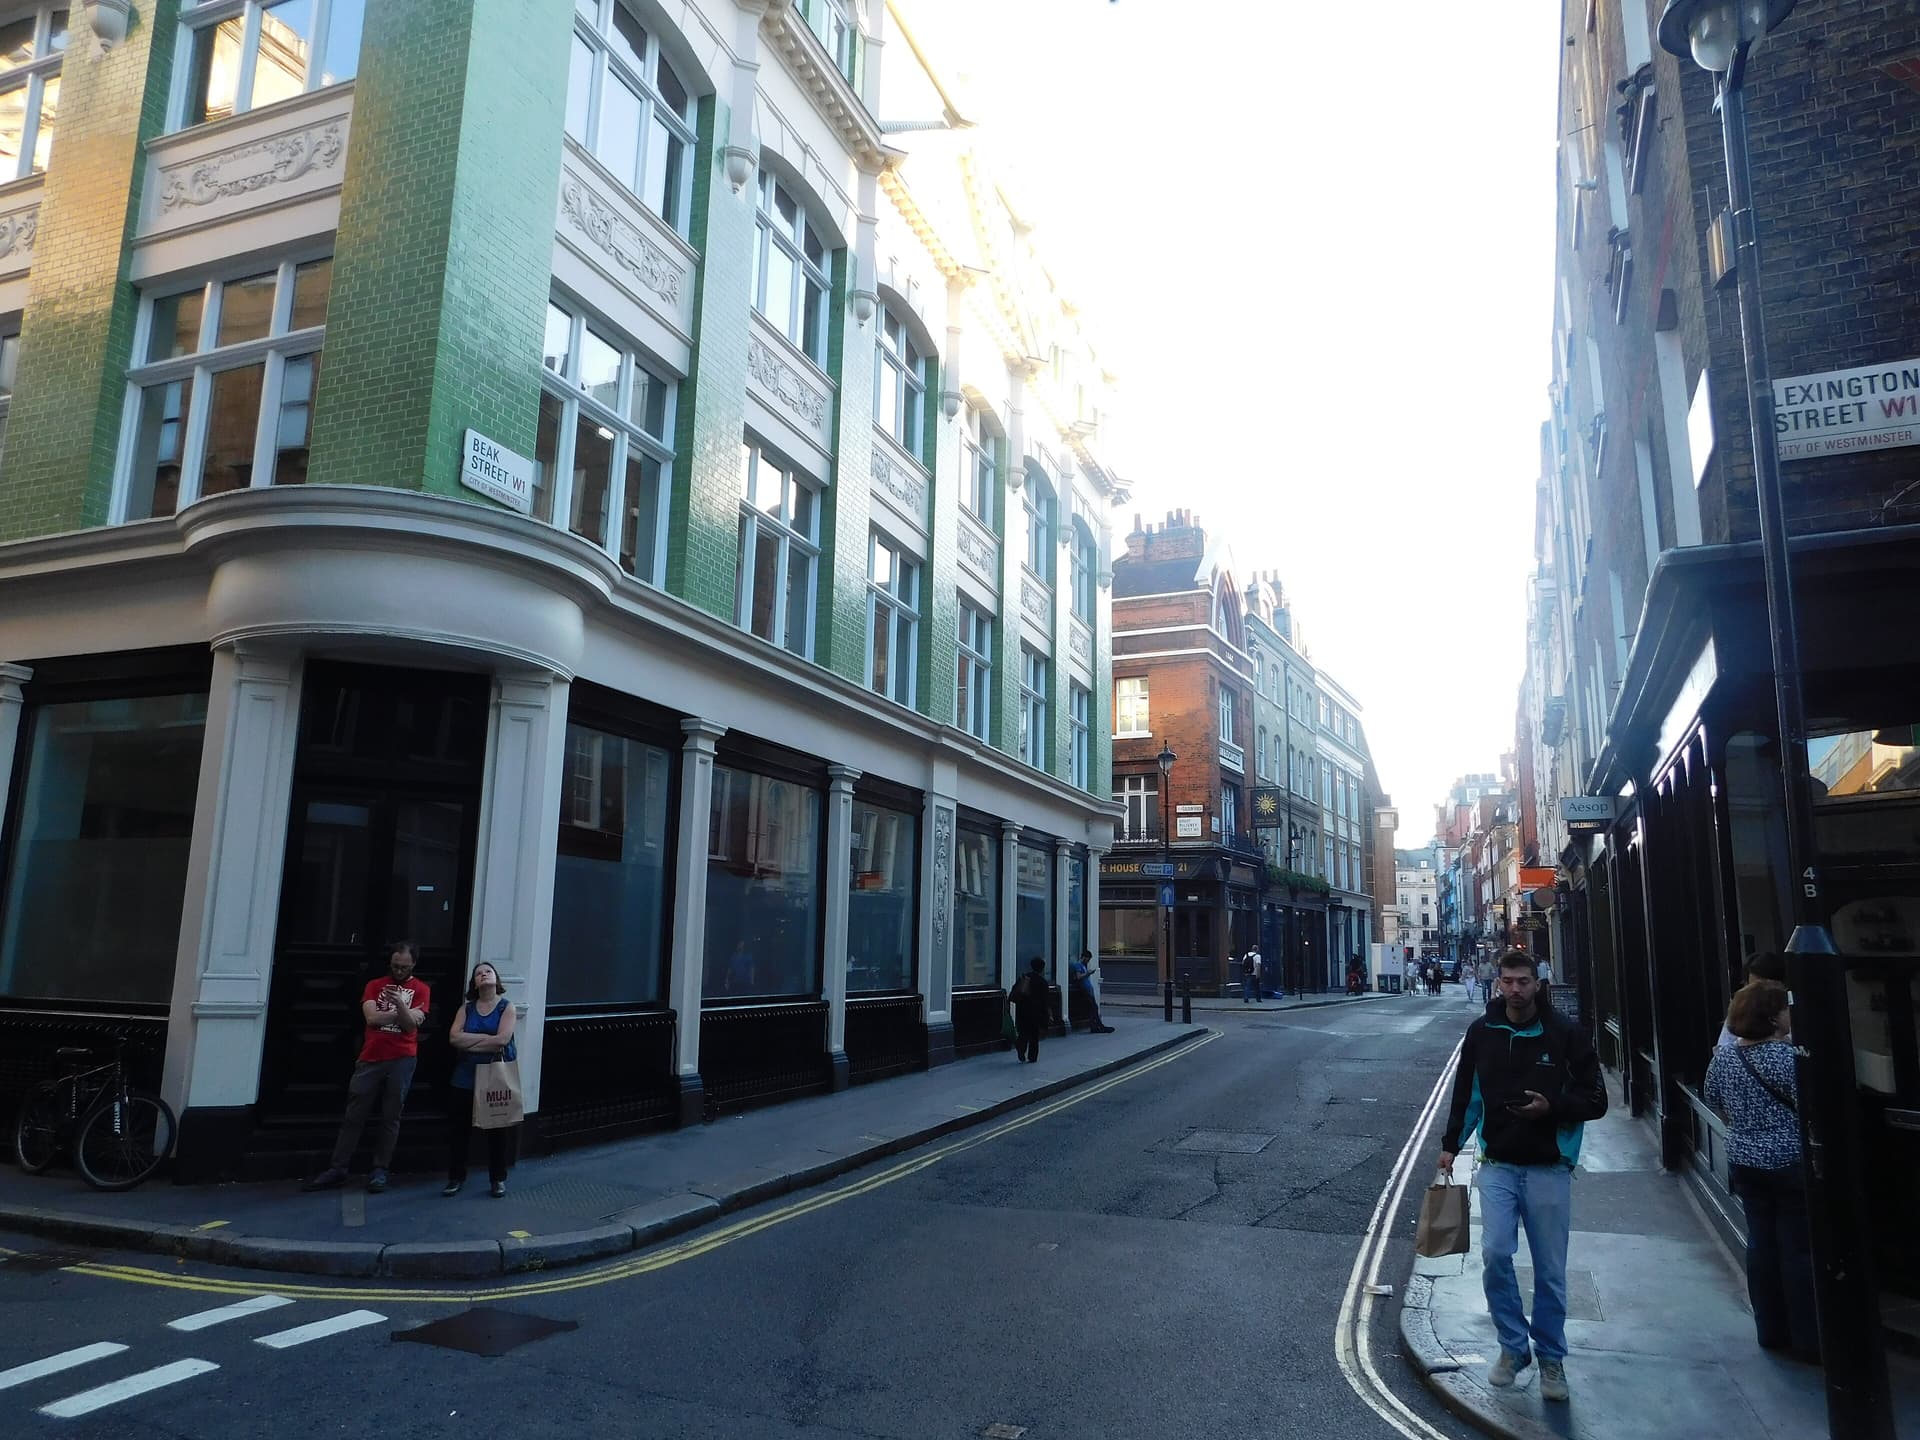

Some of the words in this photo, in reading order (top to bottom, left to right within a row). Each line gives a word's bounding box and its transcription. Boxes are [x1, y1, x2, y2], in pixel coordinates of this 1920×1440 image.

[1775, 402, 1867, 433] STREET
[1879, 394, 1917, 419] W1
[472, 437, 500, 463] BEAK
[1777, 444, 1800, 456] CITY
[1806, 441, 1821, 451] OF
[1824, 430, 1912, 450] WESTMINSTER
[471, 455, 509, 485] STREET
[512, 475, 526, 494] W1
[1568, 802, 1608, 814] Aesop
[1109, 863, 1140, 873] HOUSE
[1178, 863, 1187, 872] 21
[1803, 866, 1815, 880] 4
[1804, 884, 1817, 897] B
[486, 1090, 511, 1103] MUJI
